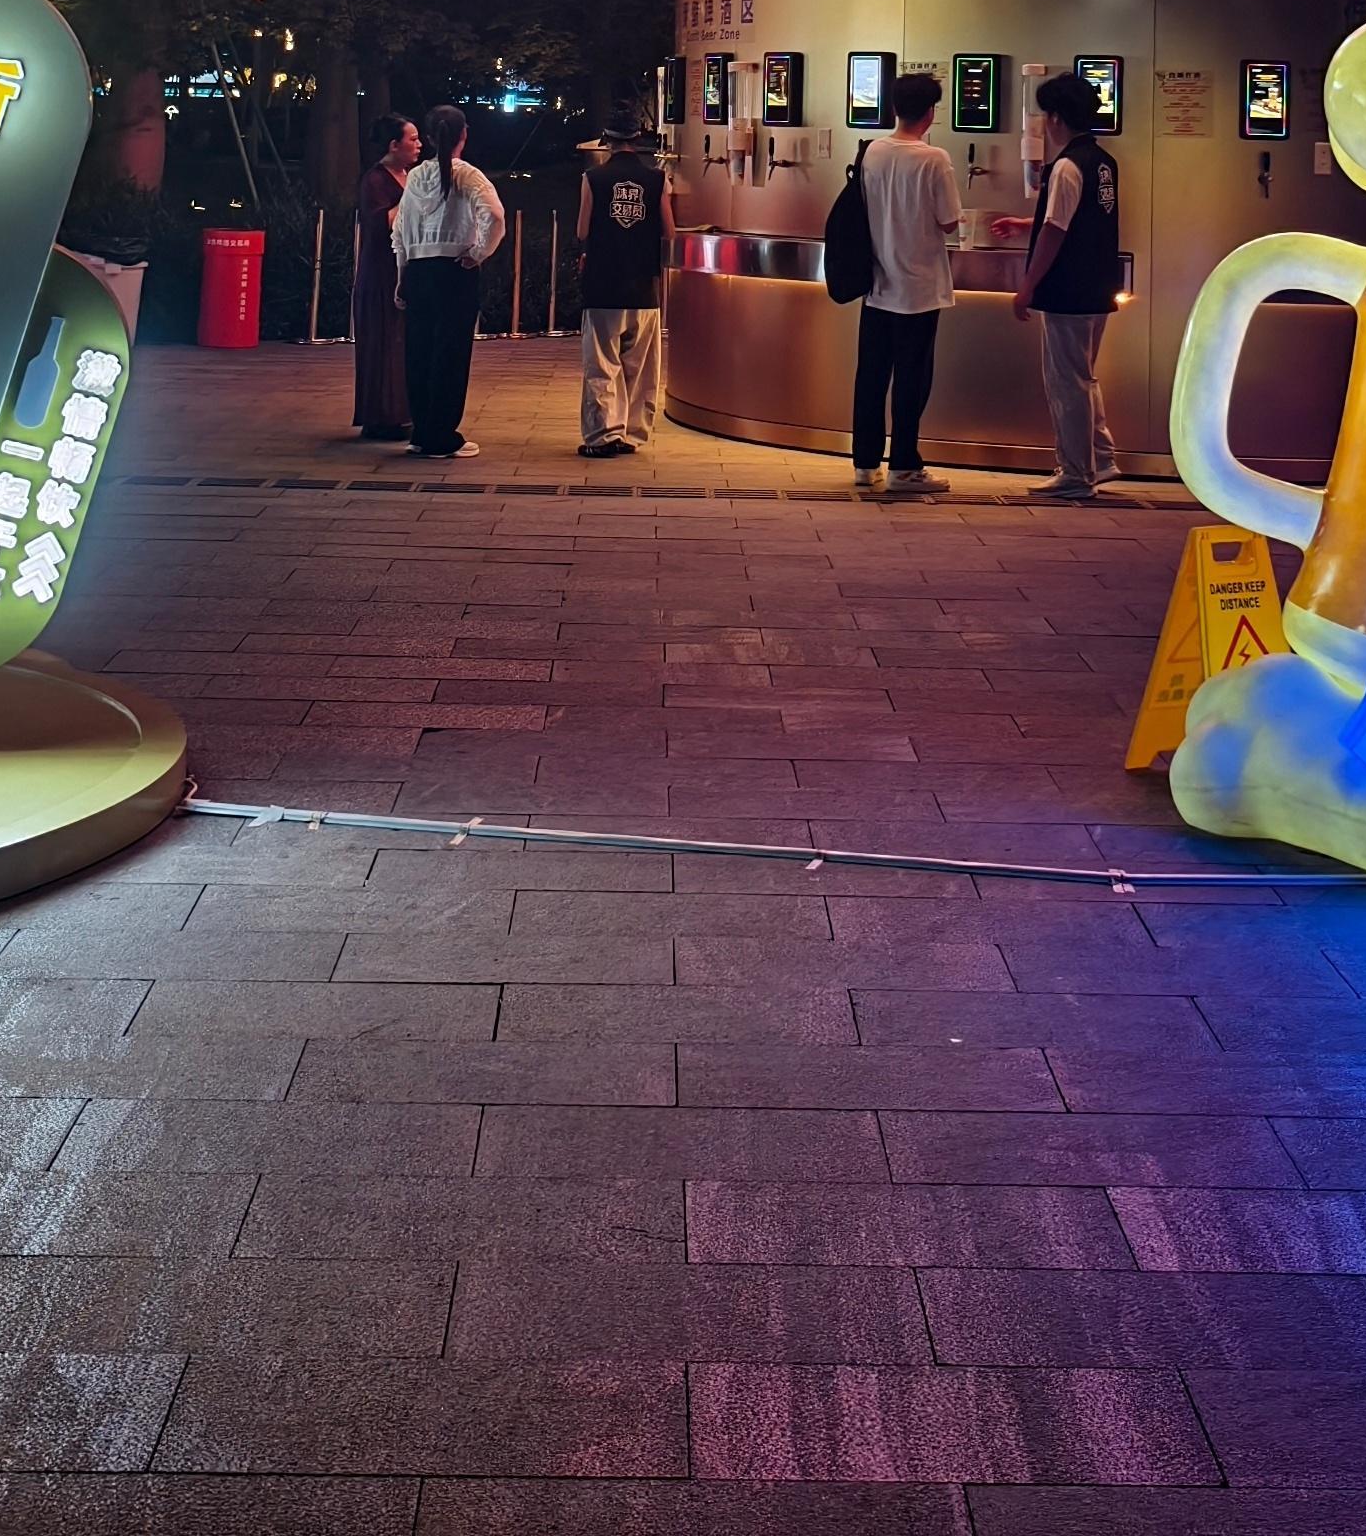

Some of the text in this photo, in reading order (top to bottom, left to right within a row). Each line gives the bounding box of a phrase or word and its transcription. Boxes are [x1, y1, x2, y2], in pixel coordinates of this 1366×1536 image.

[719, 29, 740, 40] Zone
[612, 204, 642, 218] 交易员
[1210, 580, 1266, 594] DANGER KEEP
[1220, 596, 1261, 611] DISTANCE
